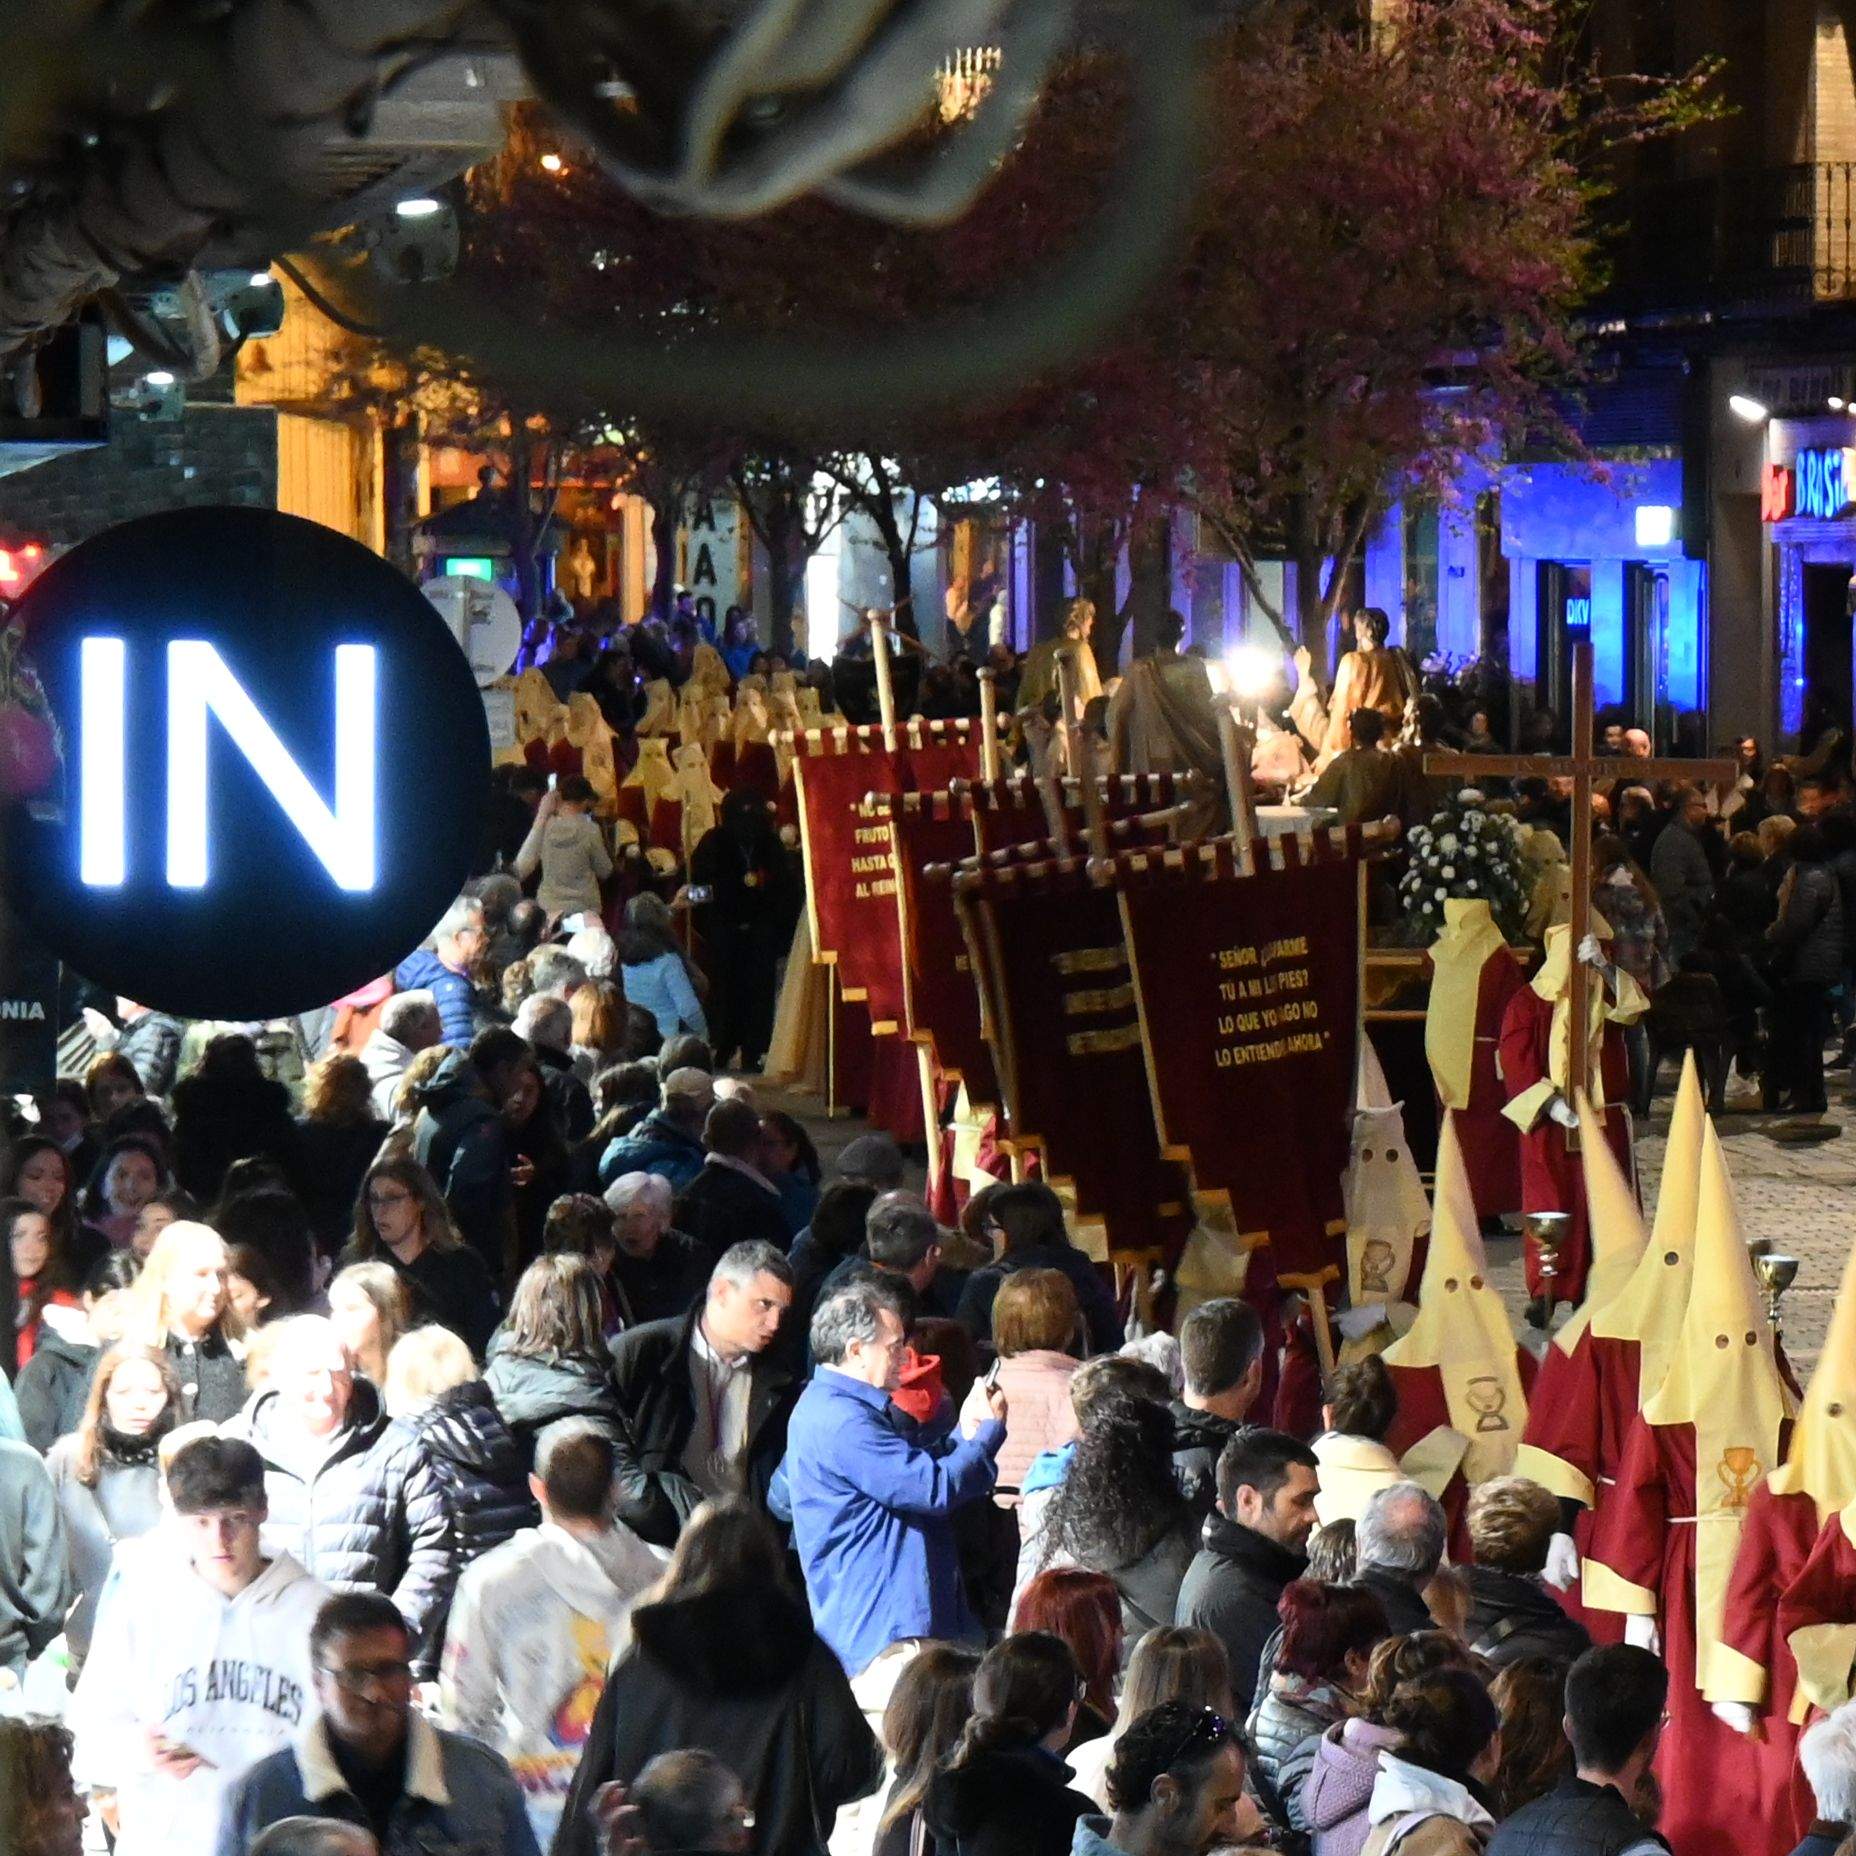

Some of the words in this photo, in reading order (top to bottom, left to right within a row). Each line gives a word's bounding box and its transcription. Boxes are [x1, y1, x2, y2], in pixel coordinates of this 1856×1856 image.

[1566, 599, 1590, 625] DKV
[81, 637, 376, 891] IN
[0, 1001, 45, 1020] NIA
